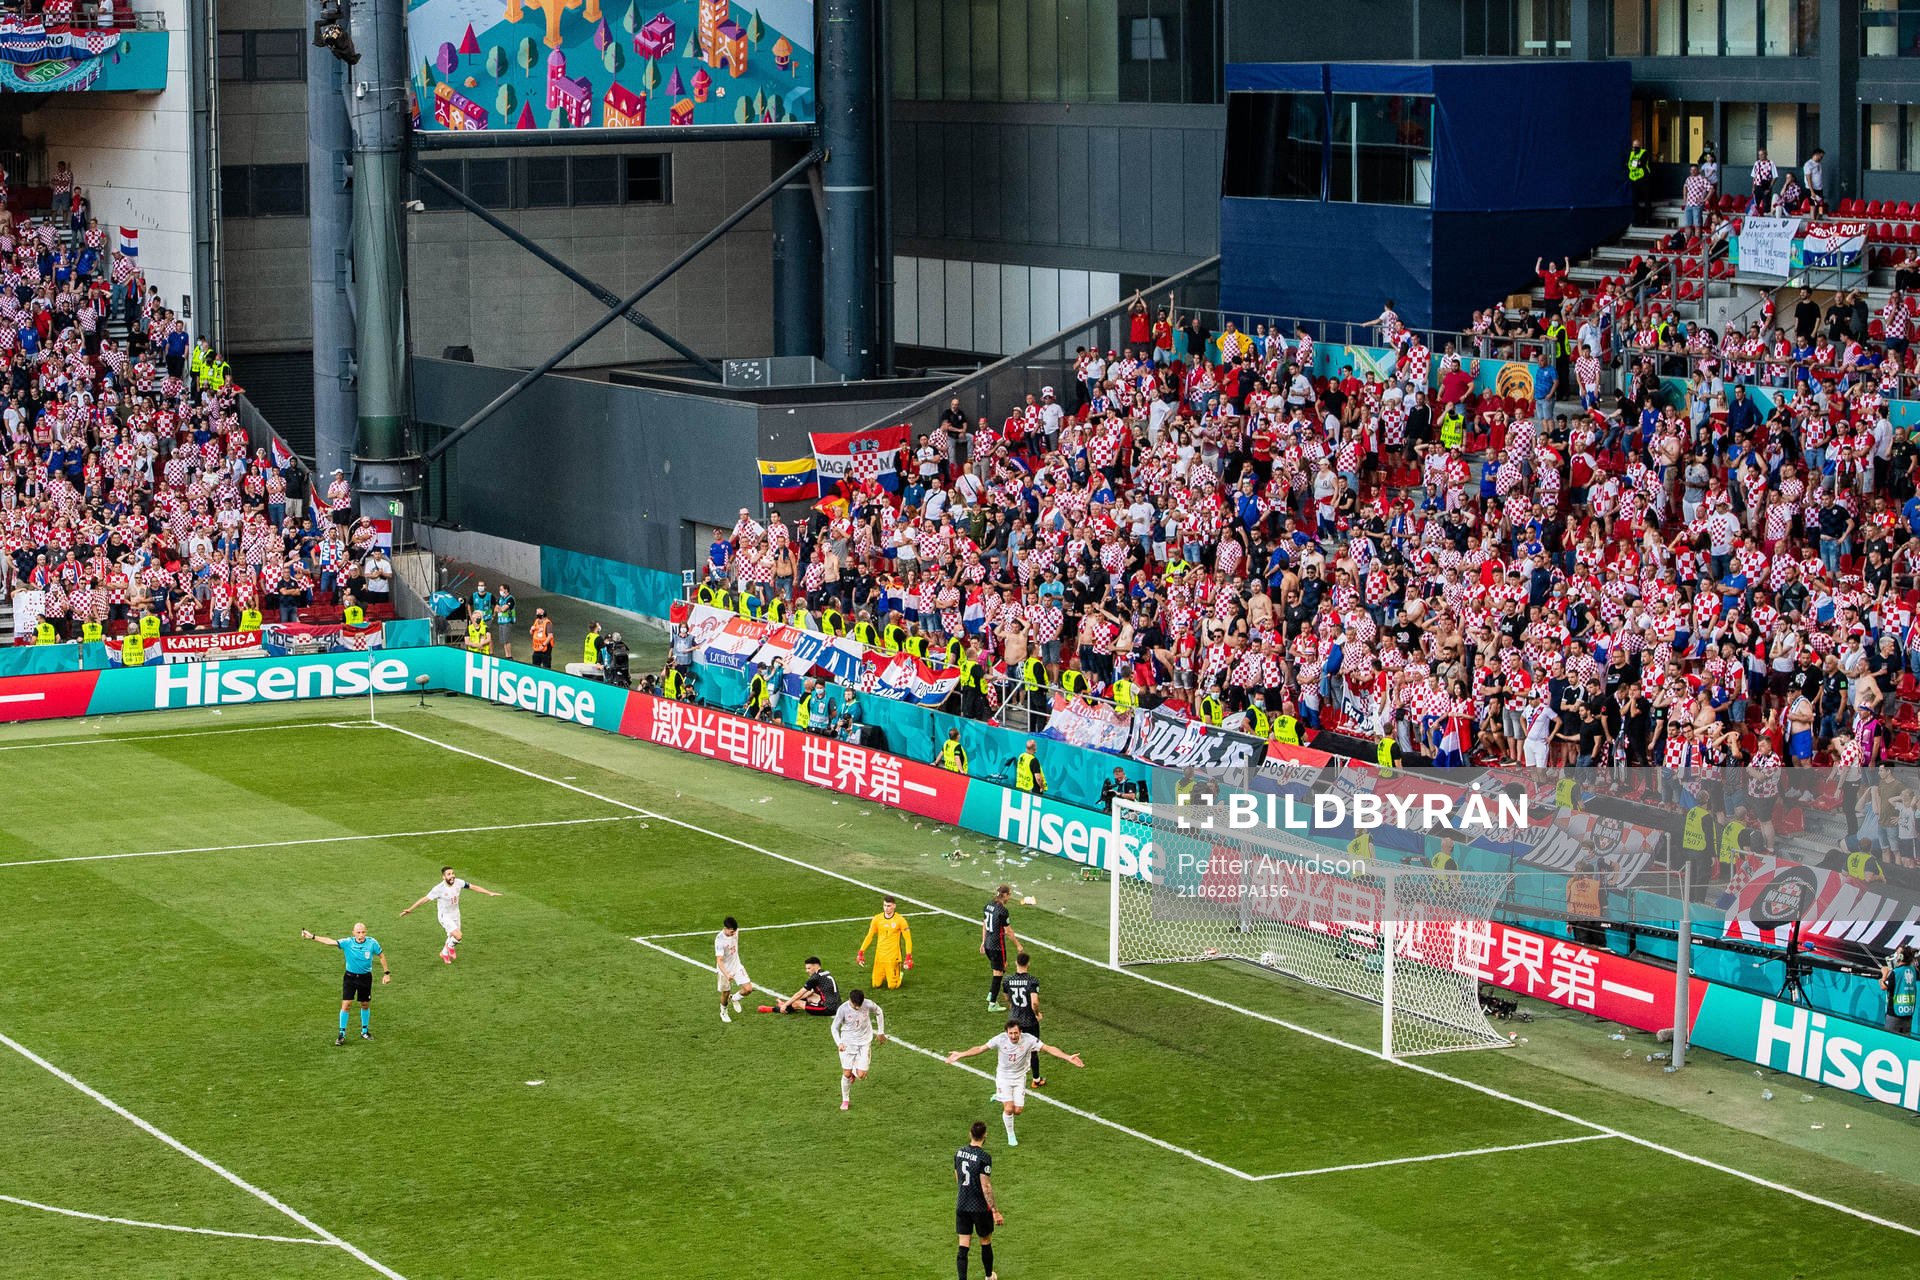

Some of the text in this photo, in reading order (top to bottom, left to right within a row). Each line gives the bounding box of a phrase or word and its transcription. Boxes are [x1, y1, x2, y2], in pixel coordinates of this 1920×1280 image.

[168, 632, 256, 649] KAMEŠNICA
[155, 659, 409, 708] Hisense
[464, 651, 596, 726] Hisense
[651, 698, 936, 805] 激光电视 世界第一
[999, 787, 1166, 885] Hisense
[1010, 986, 1028, 1008] 25
[961, 1160, 971, 1187] 5
